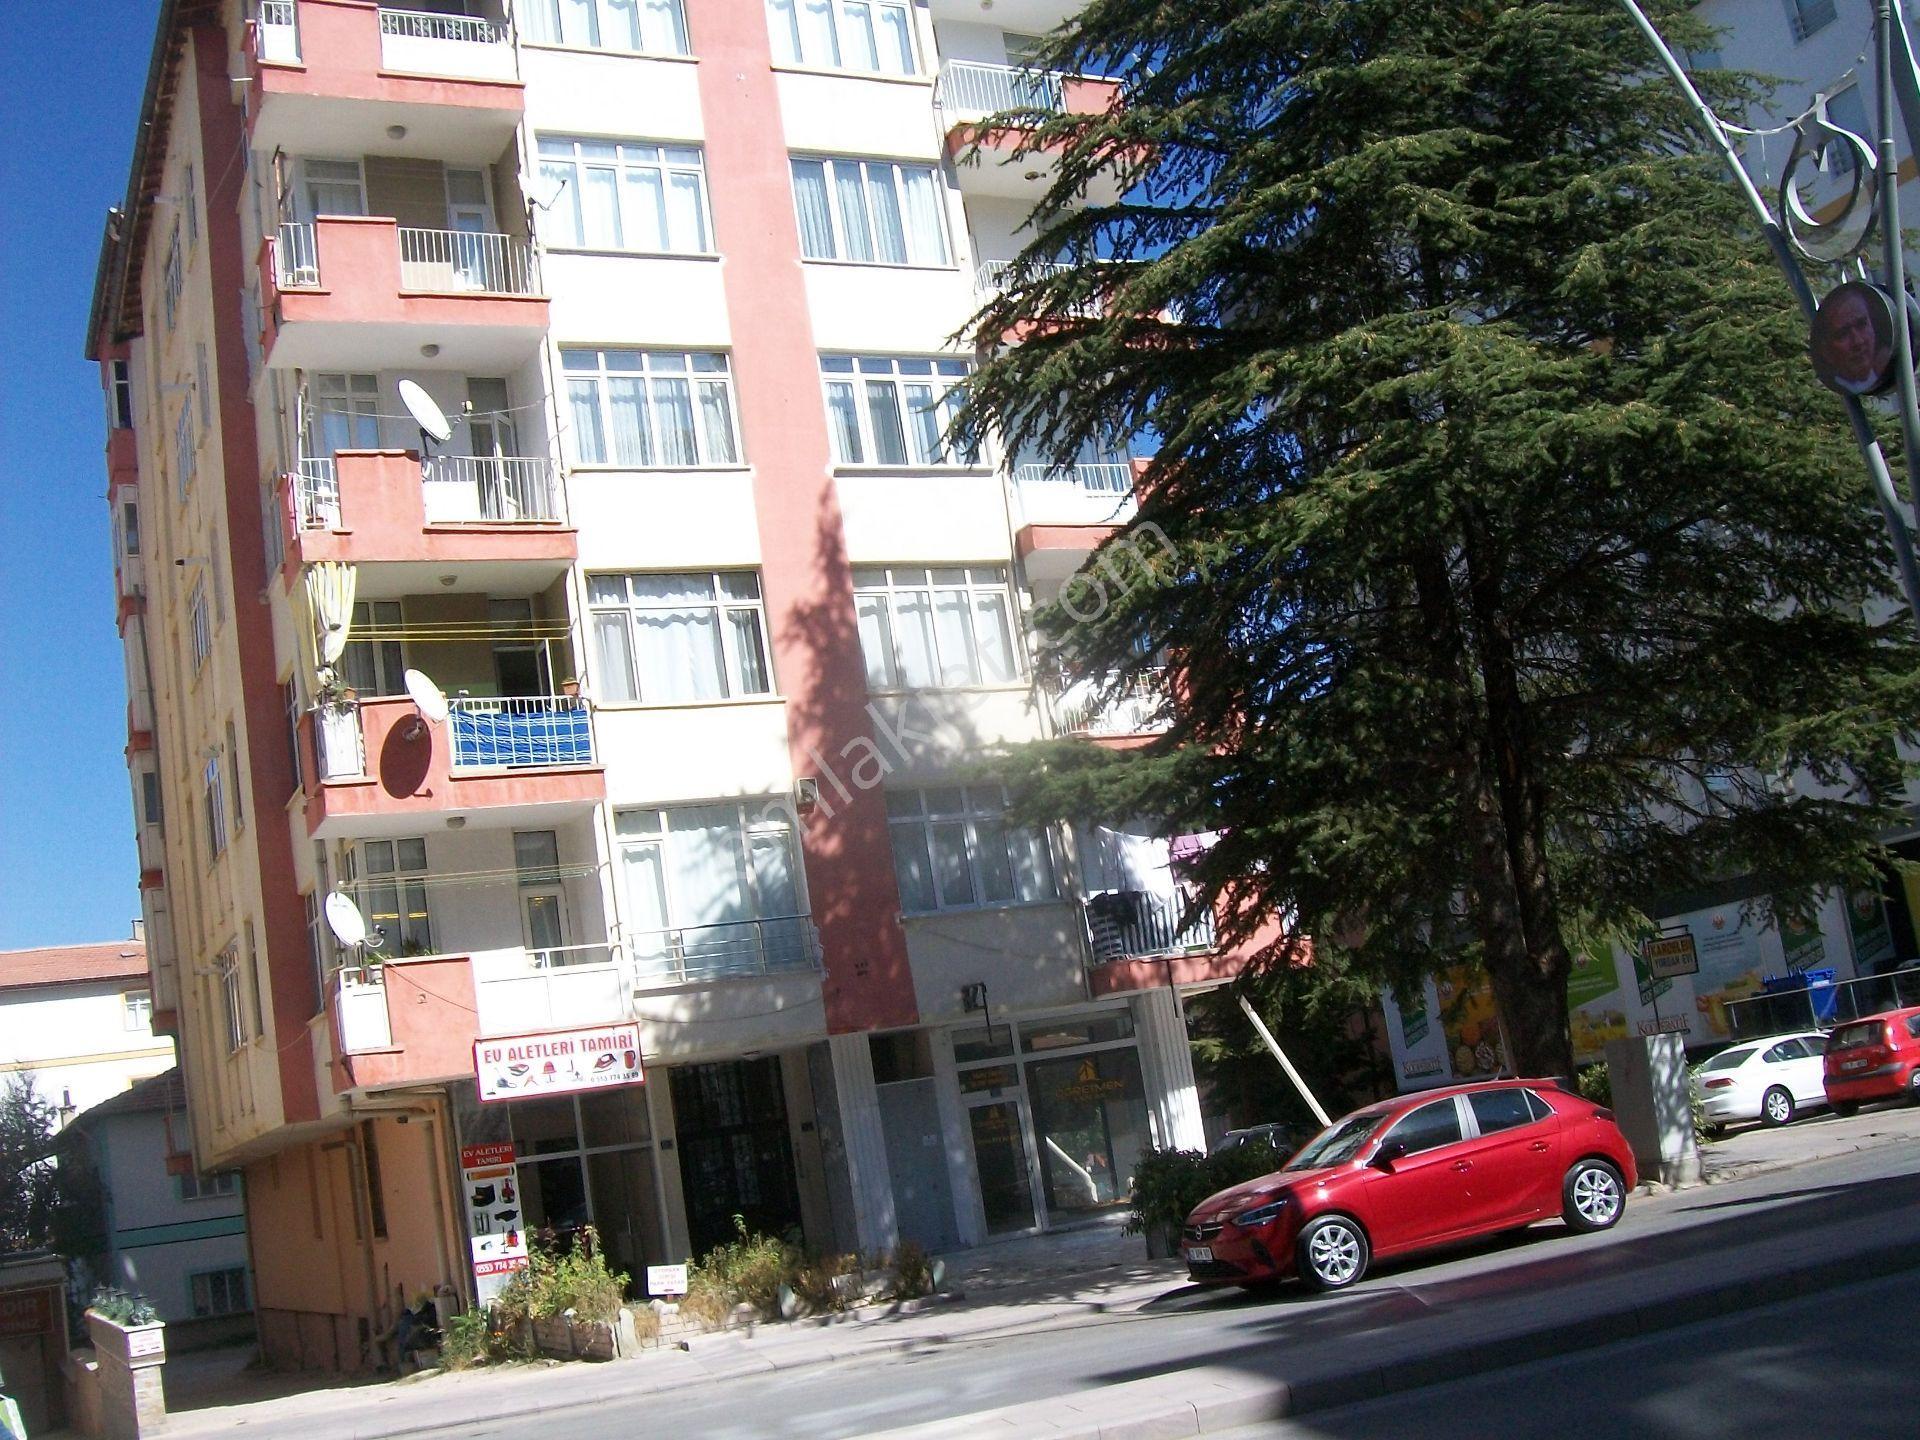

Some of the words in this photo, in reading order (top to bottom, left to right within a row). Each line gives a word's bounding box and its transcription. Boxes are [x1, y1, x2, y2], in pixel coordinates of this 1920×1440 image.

[508, 1037, 574, 1062] ALETLERİ
[580, 1031, 634, 1052] TAMİRİ
[463, 1150, 474, 1158] EV
